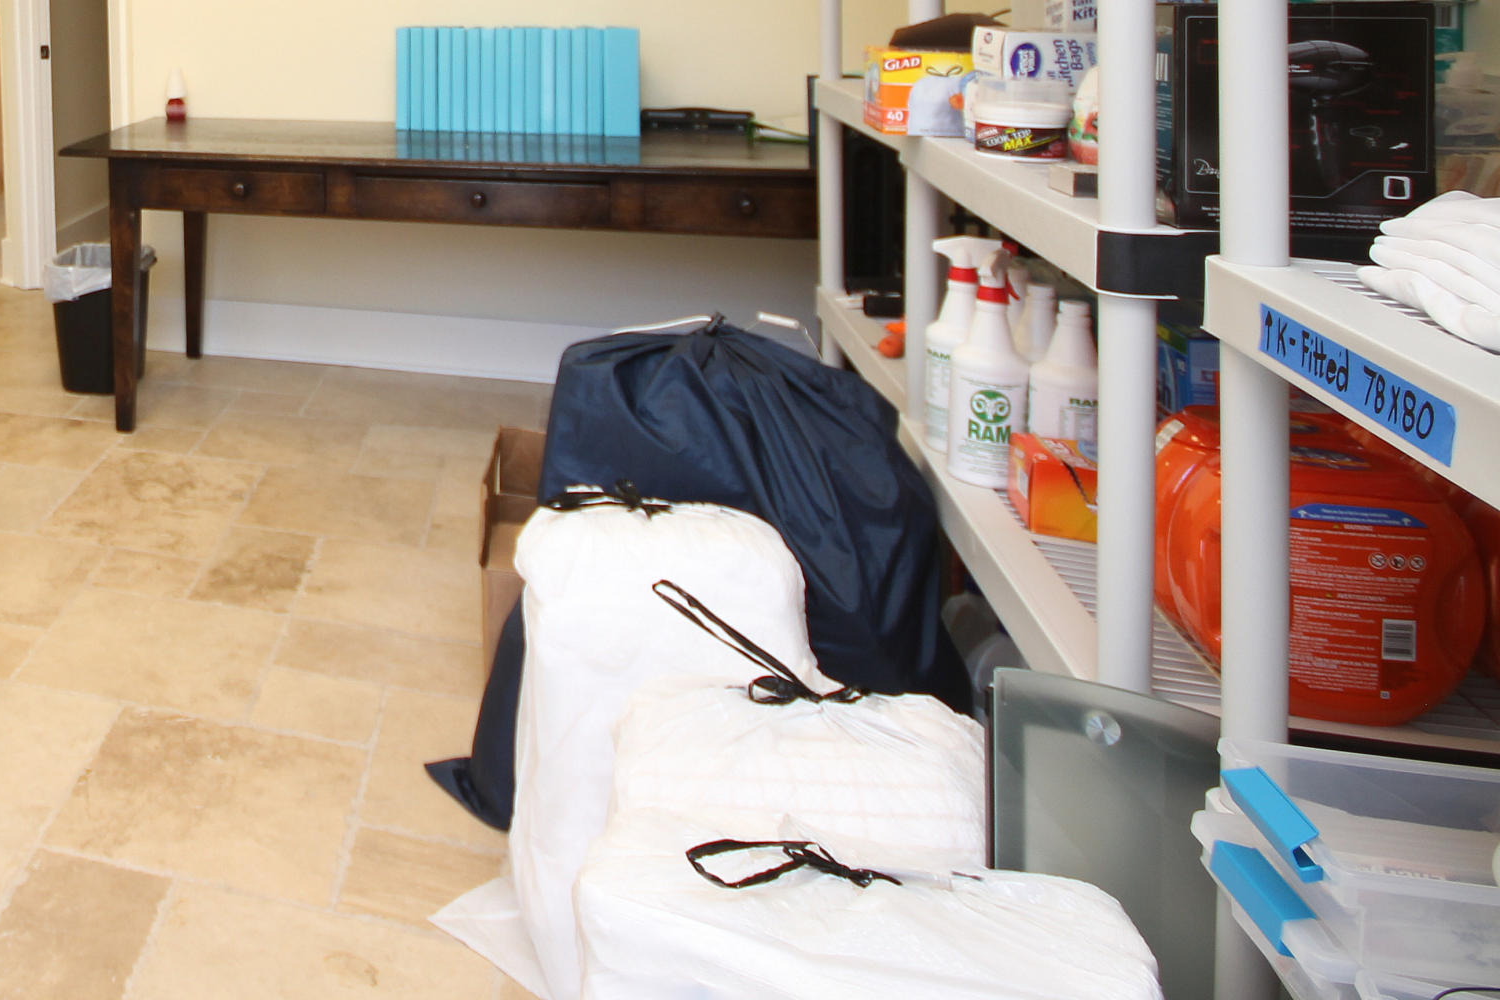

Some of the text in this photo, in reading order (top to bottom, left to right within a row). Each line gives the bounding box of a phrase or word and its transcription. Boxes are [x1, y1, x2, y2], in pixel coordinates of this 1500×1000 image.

[1067, 39, 1084, 71] Bags
[884, 56, 921, 72] GLAD
[886, 111, 904, 122] 40
[985, 133, 1010, 148] COOK
[1003, 134, 1033, 152] MAX
[967, 418, 1012, 445] RAM
